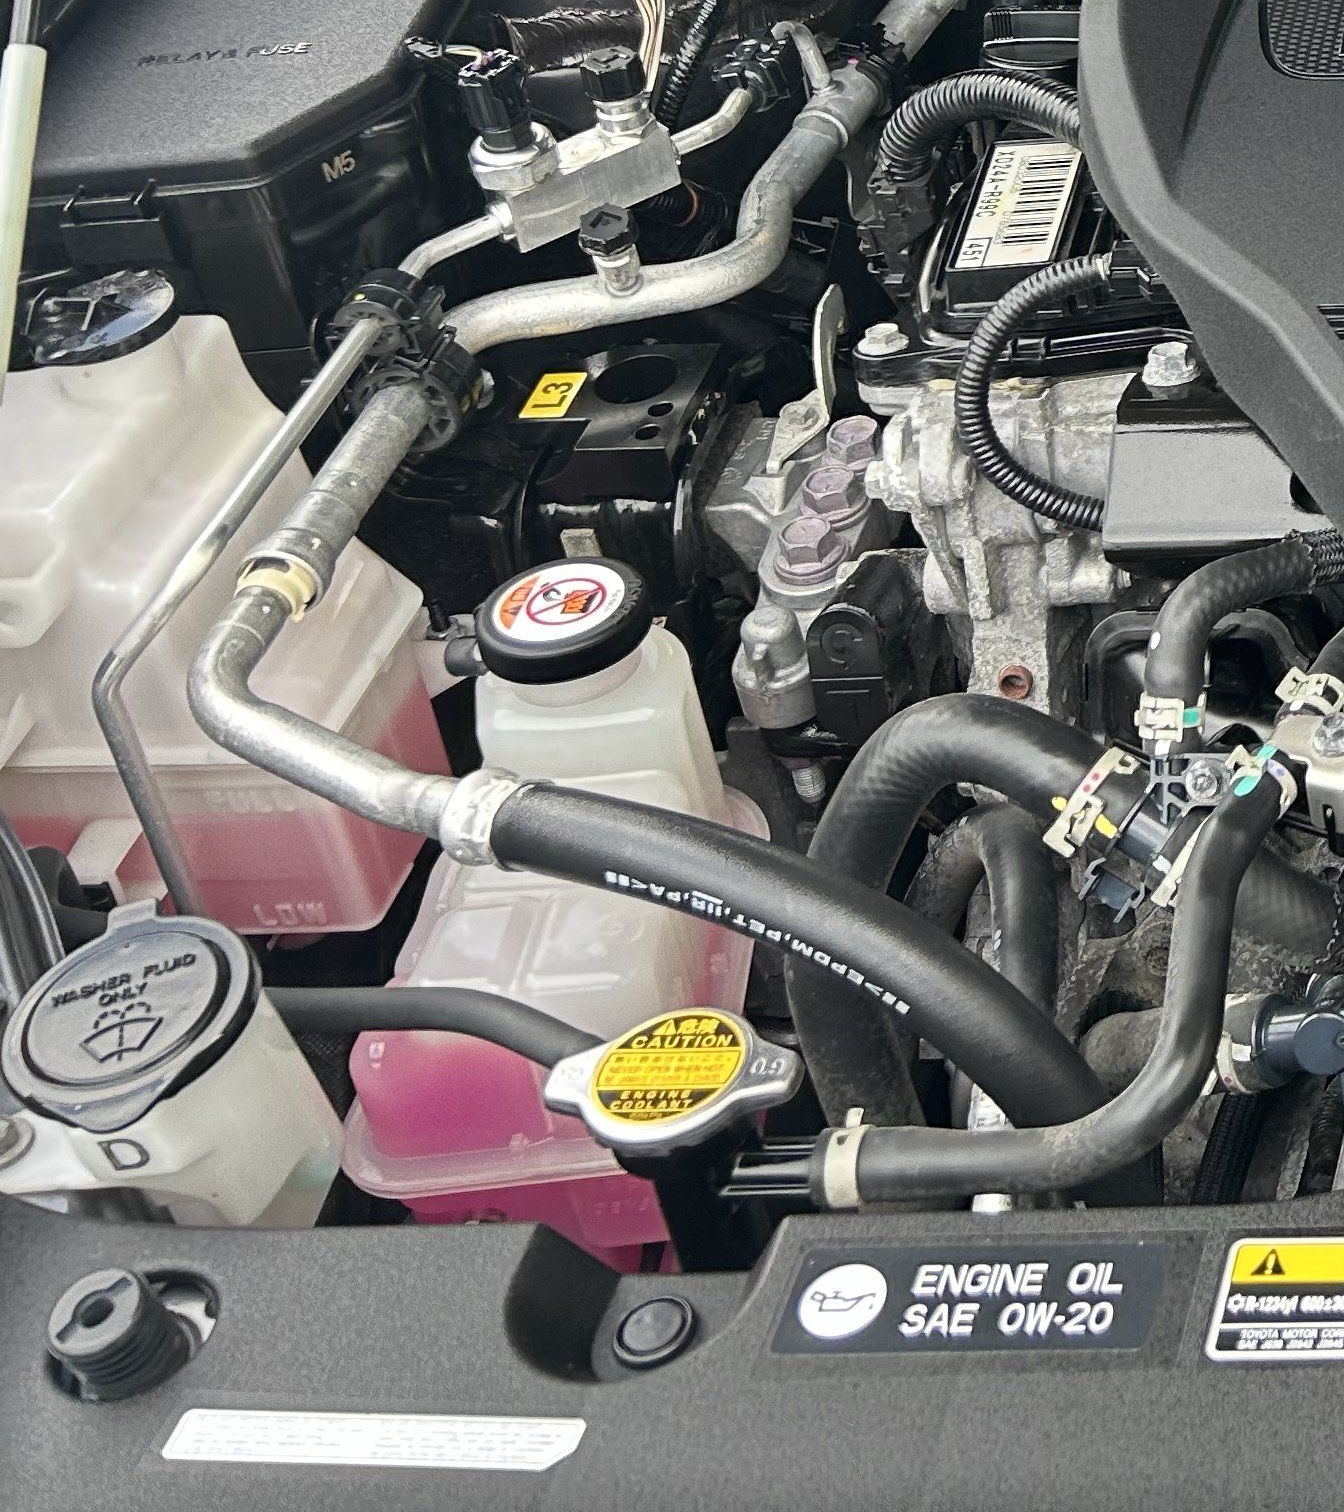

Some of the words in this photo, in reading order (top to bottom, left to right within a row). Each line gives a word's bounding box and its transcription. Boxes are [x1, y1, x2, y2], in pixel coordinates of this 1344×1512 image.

[137, 49, 222, 67] RELAY
[246, 41, 313, 59] FUSE
[321, 149, 357, 184] M5
[960, 243, 985, 261] 451
[530, 382, 574, 409] L3
[252, 899, 328, 926] LOW
[51, 972, 133, 1009] WASHER
[142, 952, 198, 980] FLUID
[98, 980, 149, 1008] ONLY
[630, 1034, 734, 1050] CAUTION
[609, 1099, 694, 1111] COOLANT
[620, 1090, 693, 1100] ENGINE
[97, 1139, 150, 1171] D
[910, 1262, 1049, 1298] ENGINE
[1065, 1261, 1124, 1297] OIL
[898, 1301, 981, 1338] SAE
[997, 1300, 1115, 1337] 0W-20
[1239, 1328, 1280, 1339] TOYOTA
[1282, 1328, 1319, 1339] MOTOR
